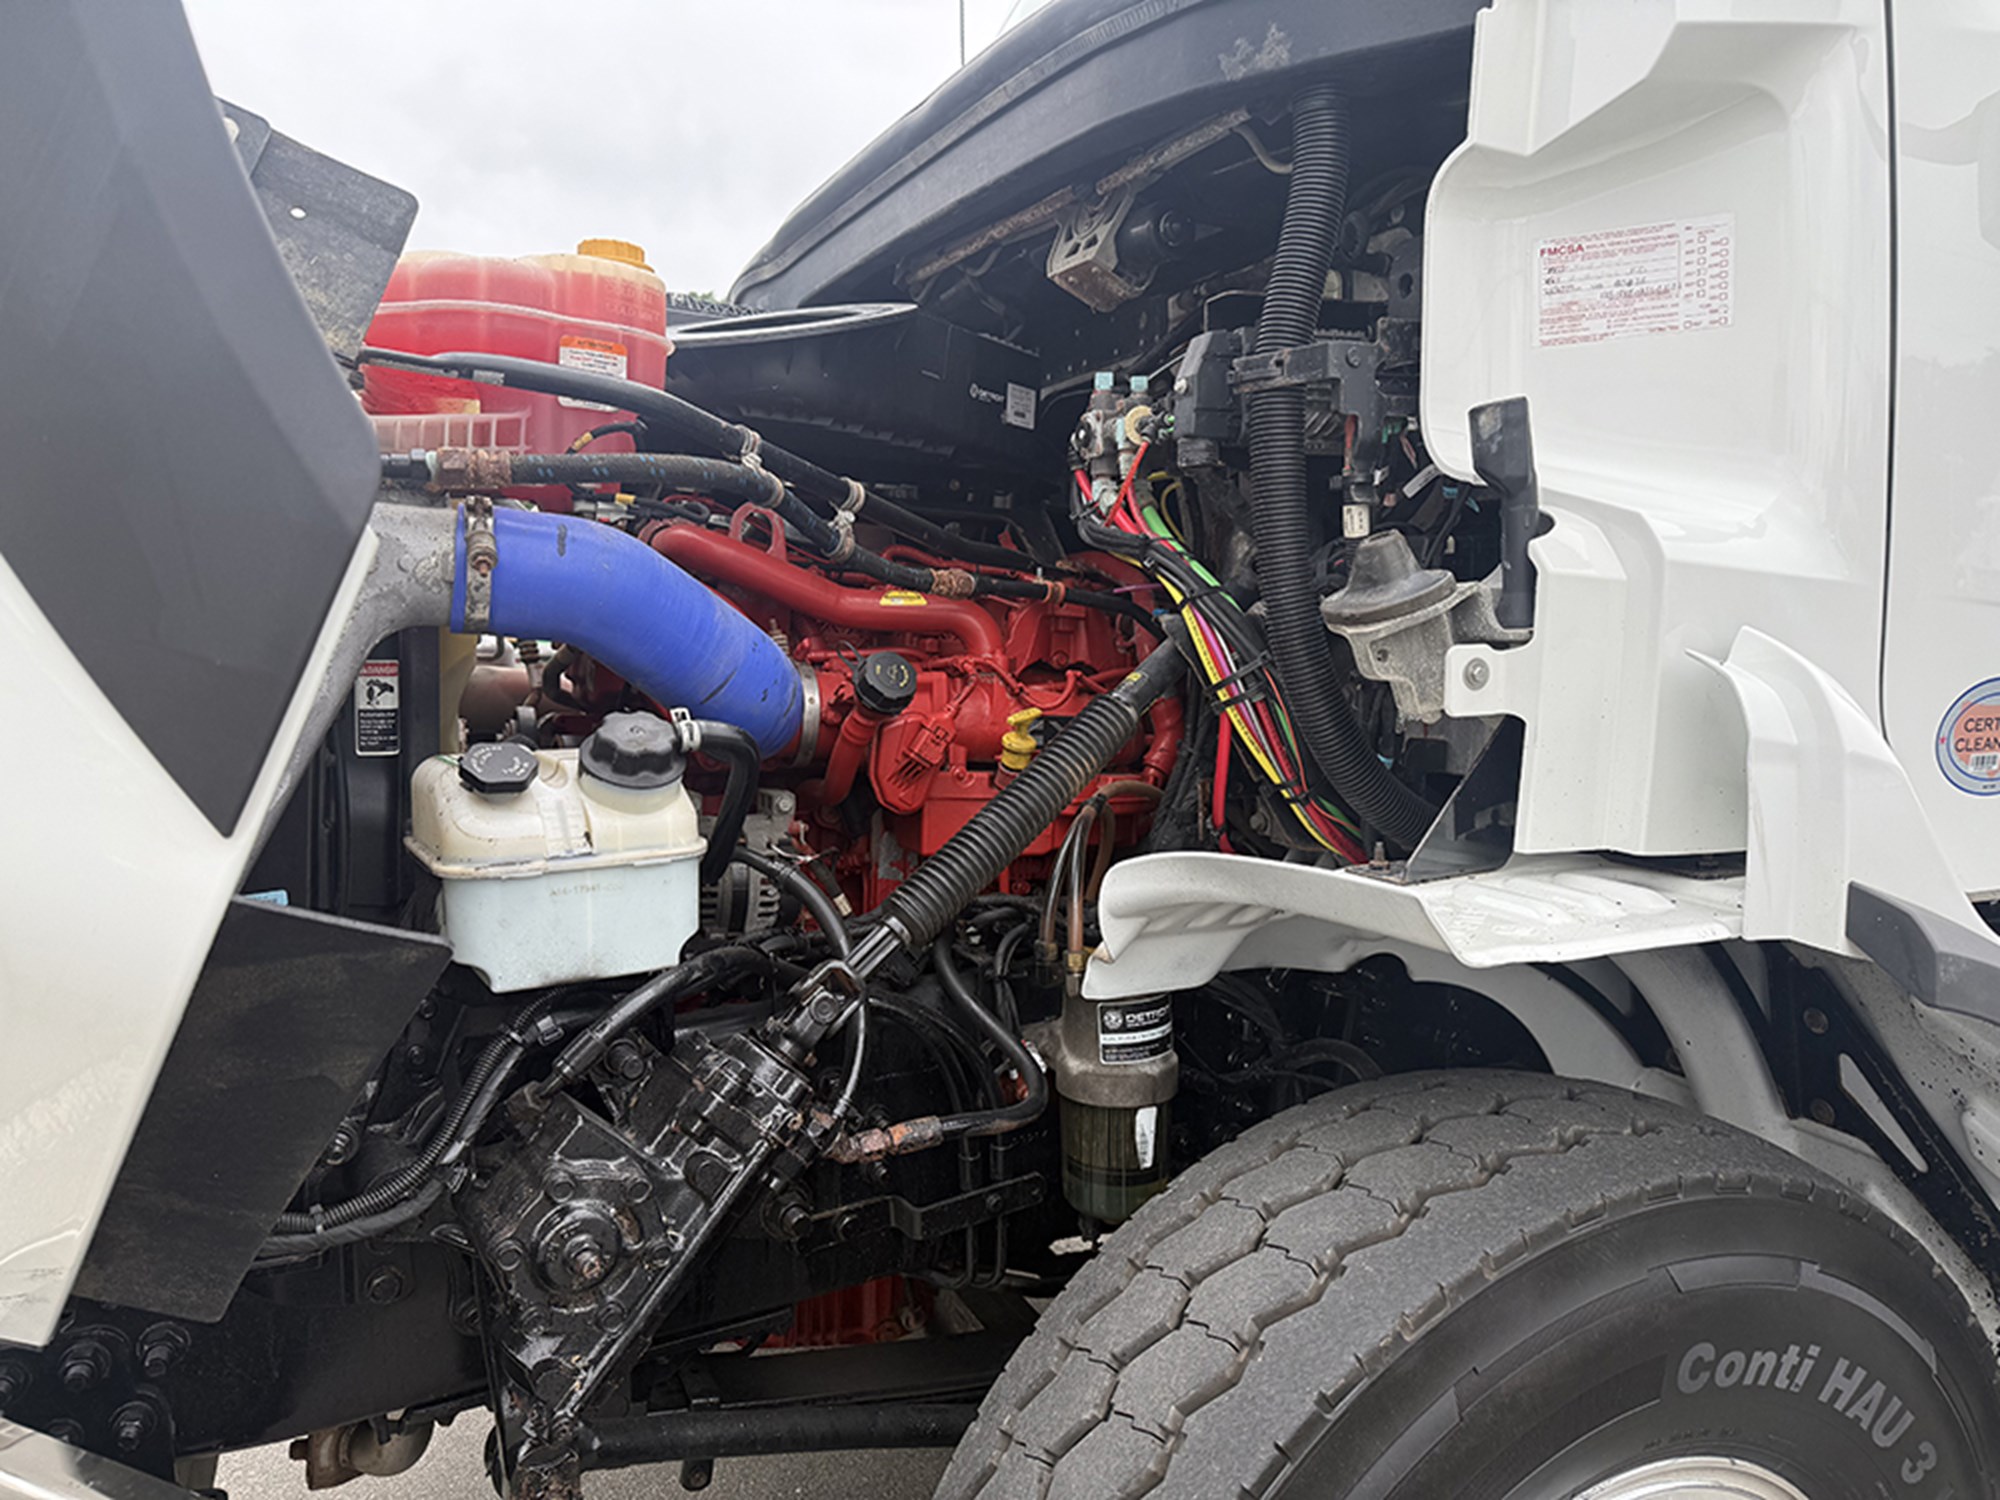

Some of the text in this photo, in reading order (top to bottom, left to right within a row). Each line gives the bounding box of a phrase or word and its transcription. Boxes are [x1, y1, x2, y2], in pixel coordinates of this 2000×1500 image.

[1540, 243, 1584, 257] FMCSA
[1677, 1341, 1938, 1484] Conti HAU 3
